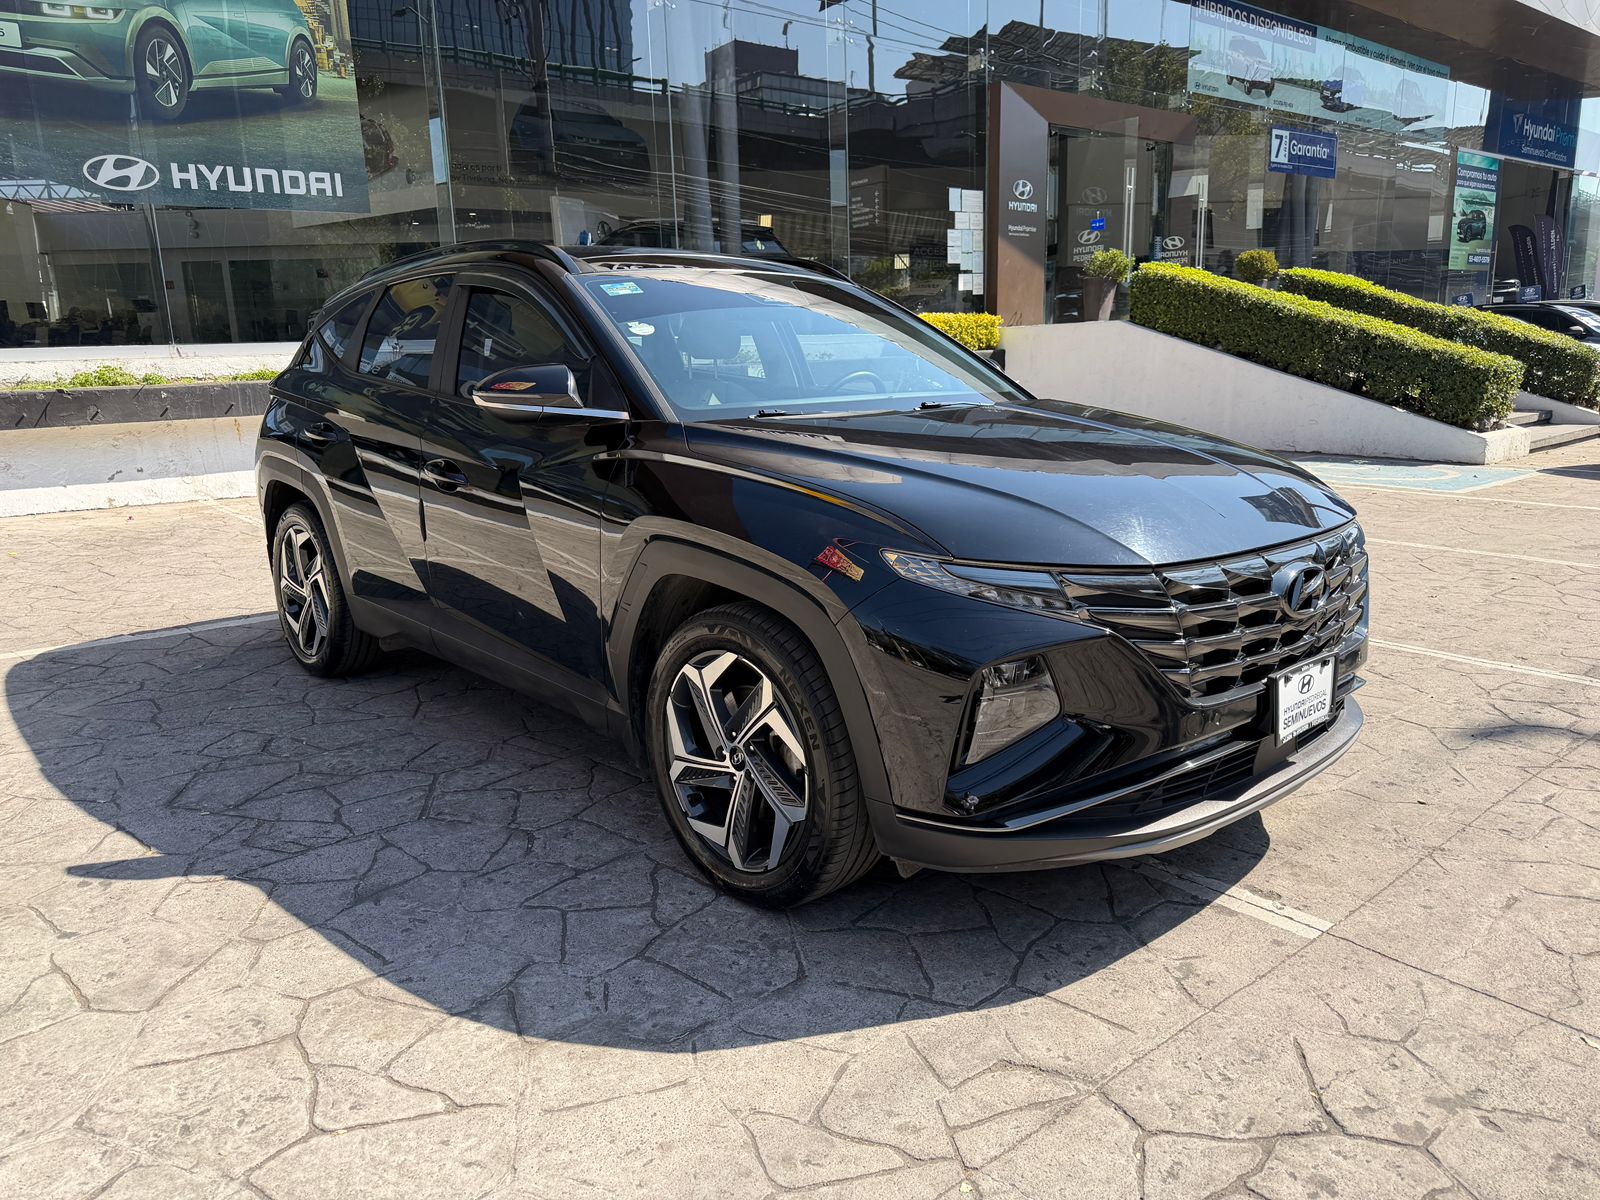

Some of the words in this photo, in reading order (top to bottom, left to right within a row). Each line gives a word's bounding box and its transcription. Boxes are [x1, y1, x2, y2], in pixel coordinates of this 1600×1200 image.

[1249, 14, 1313, 46] DISPONIBLES!
[1523, 118, 1556, 142] Hyundai
[1275, 134, 1283, 158] 7
[170, 163, 343, 197] HYUNDAI
[1457, 167, 1482, 180] Compramos
[1487, 173, 1497, 182] auto
[1008, 201, 1037, 212] HYUNDAI
[1073, 244, 1105, 254] HYUNDAI
[778, 666, 820, 751] NEXEN
[1283, 698, 1327, 730] SEMINUEVOS
